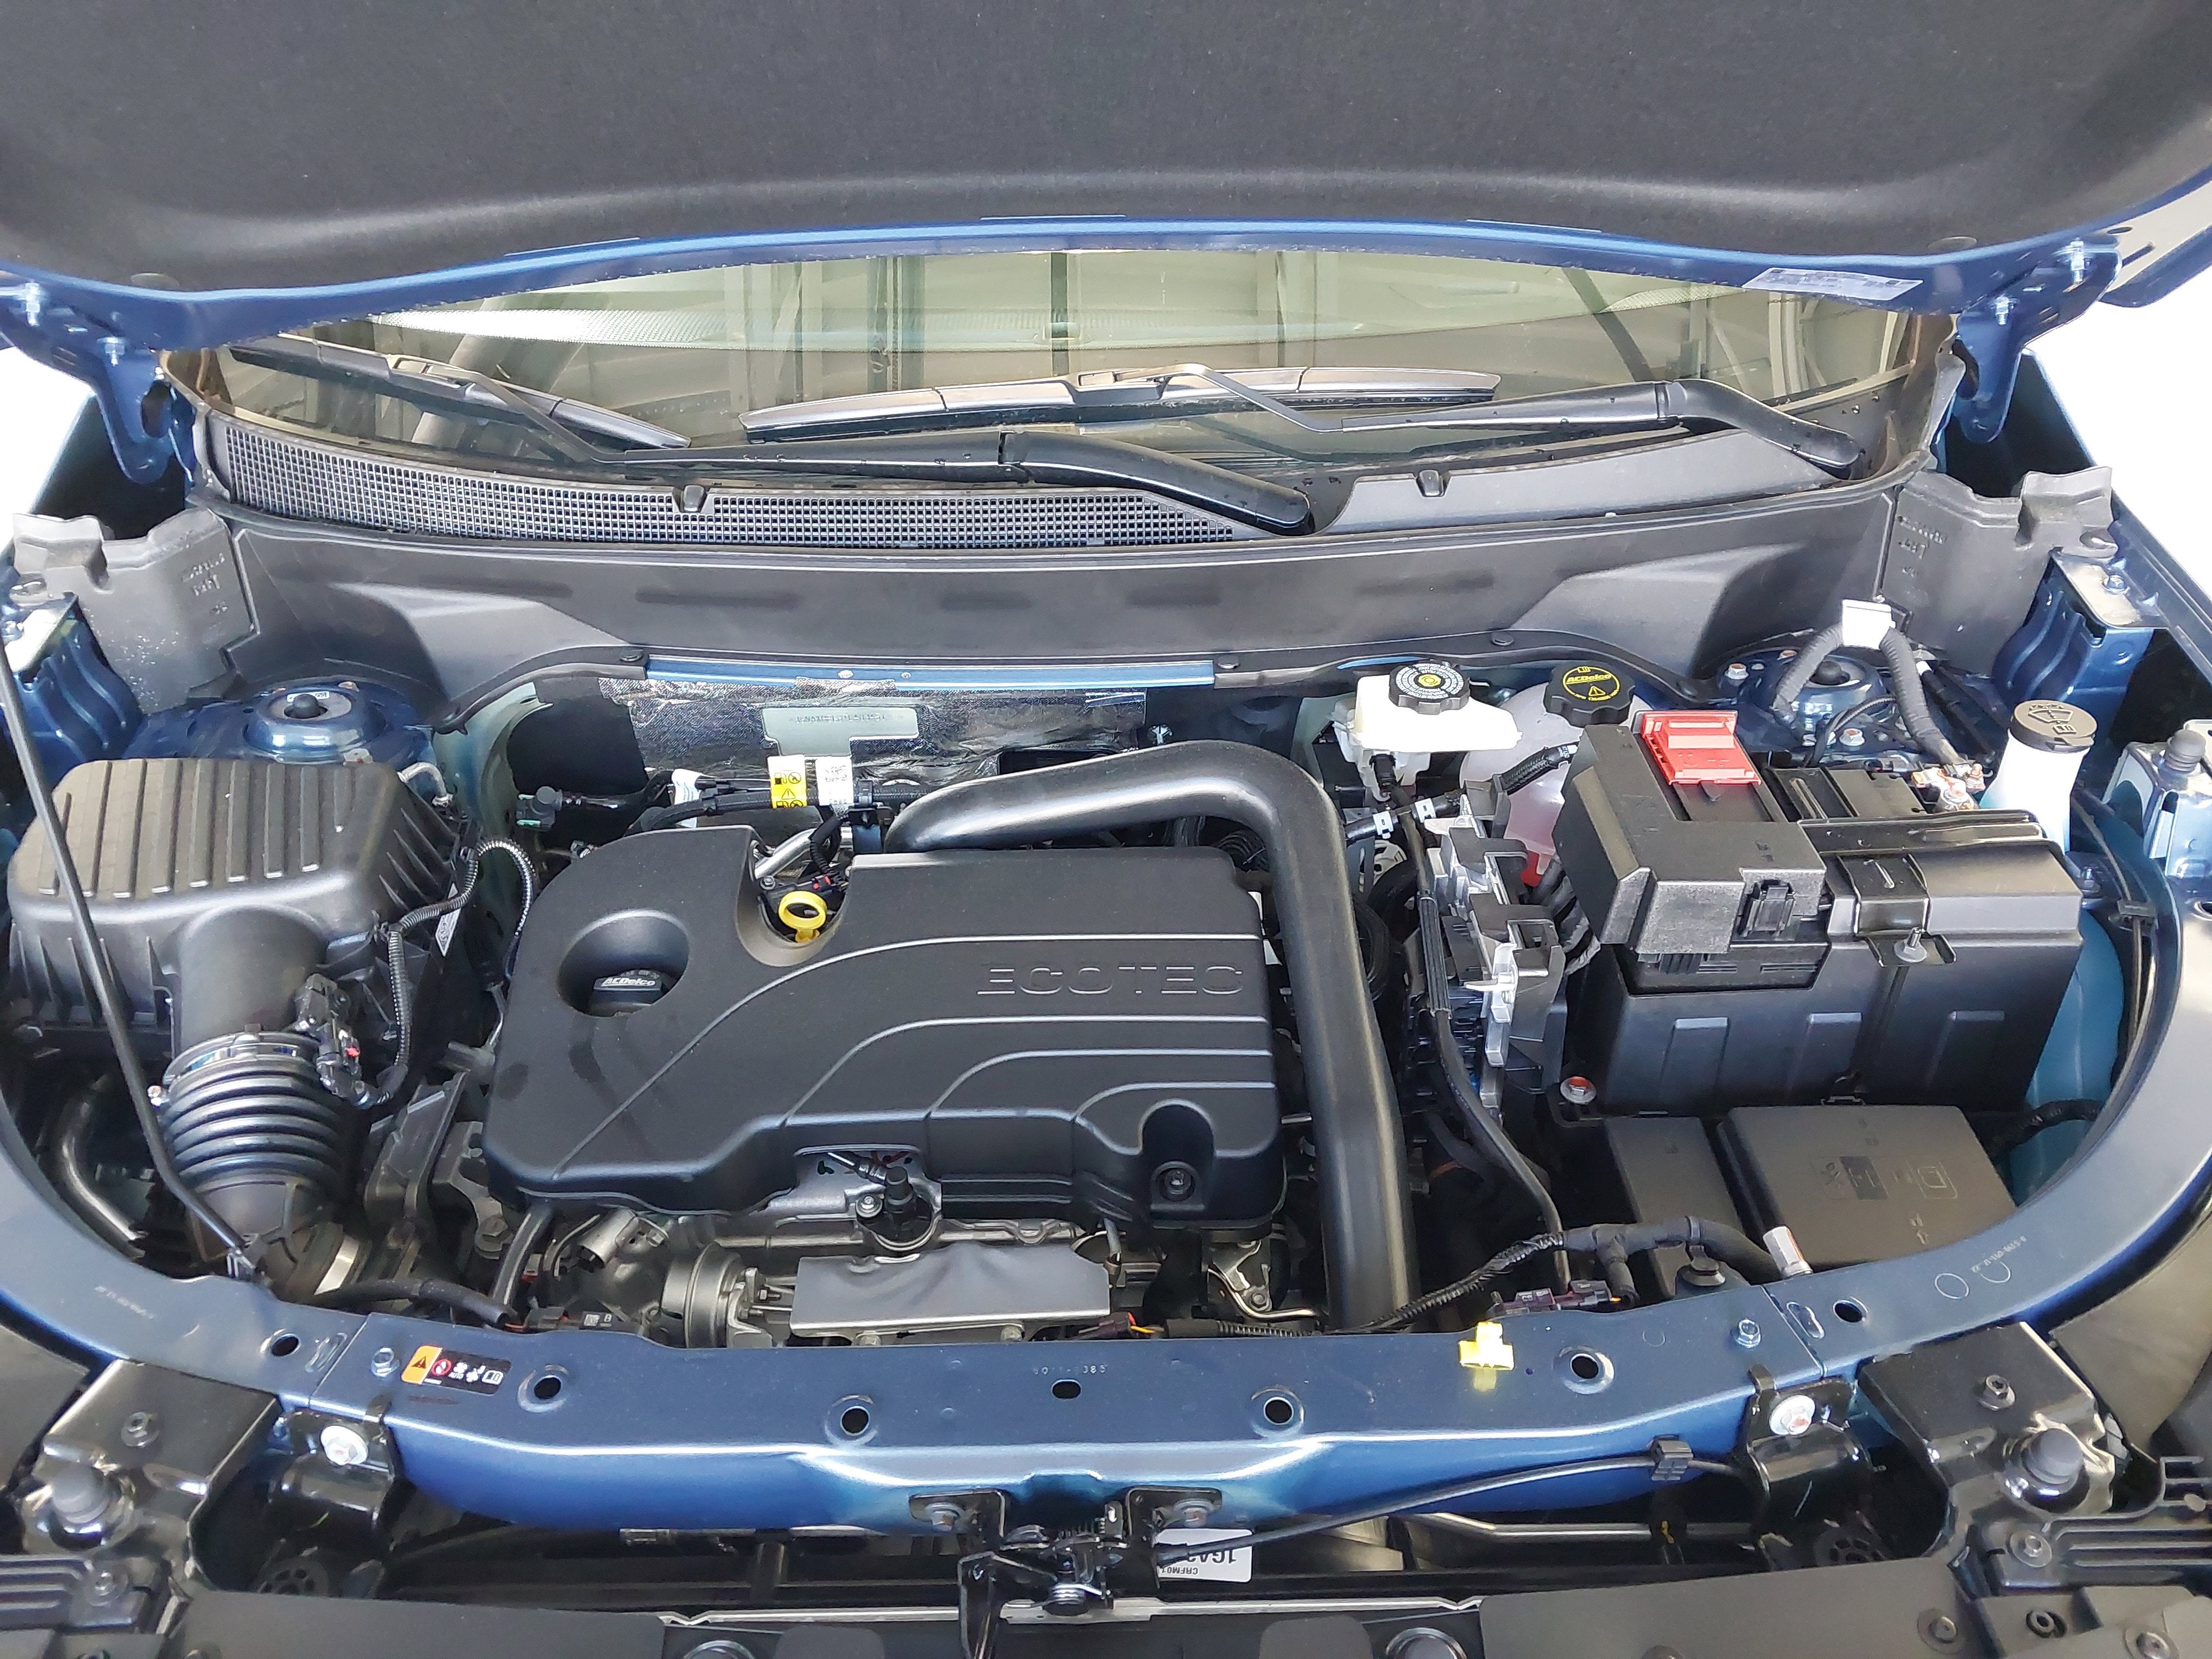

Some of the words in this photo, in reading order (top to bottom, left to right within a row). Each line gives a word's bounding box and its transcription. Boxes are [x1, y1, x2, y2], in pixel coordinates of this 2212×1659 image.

[1566, 673, 1613, 683] ACDelco
[601, 977, 656, 987] ACDelco
[976, 964, 1244, 996] ECOTEC
